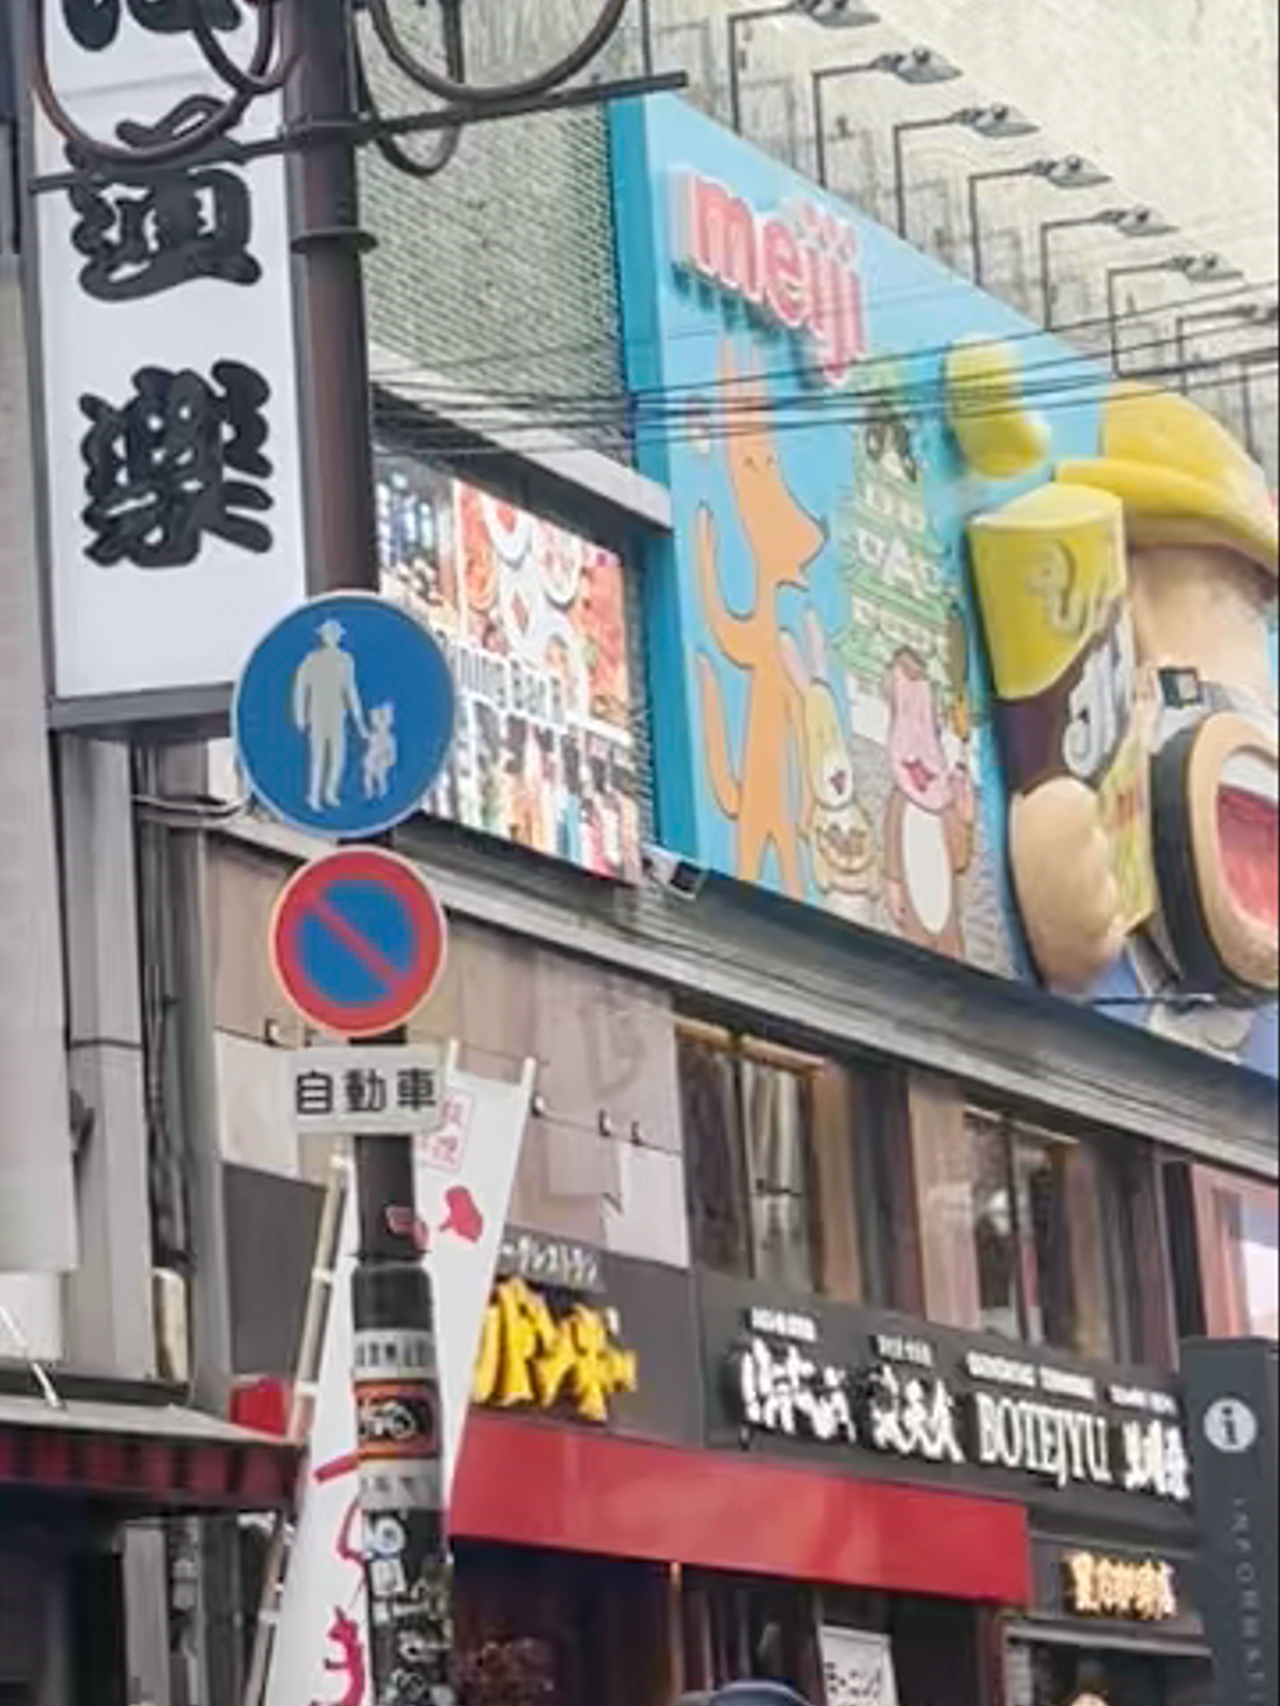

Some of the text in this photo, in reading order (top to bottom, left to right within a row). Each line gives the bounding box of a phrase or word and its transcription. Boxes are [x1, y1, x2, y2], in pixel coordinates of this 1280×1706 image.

[682, 174, 868, 384] meiji
[296, 1067, 437, 1115] 自動車
